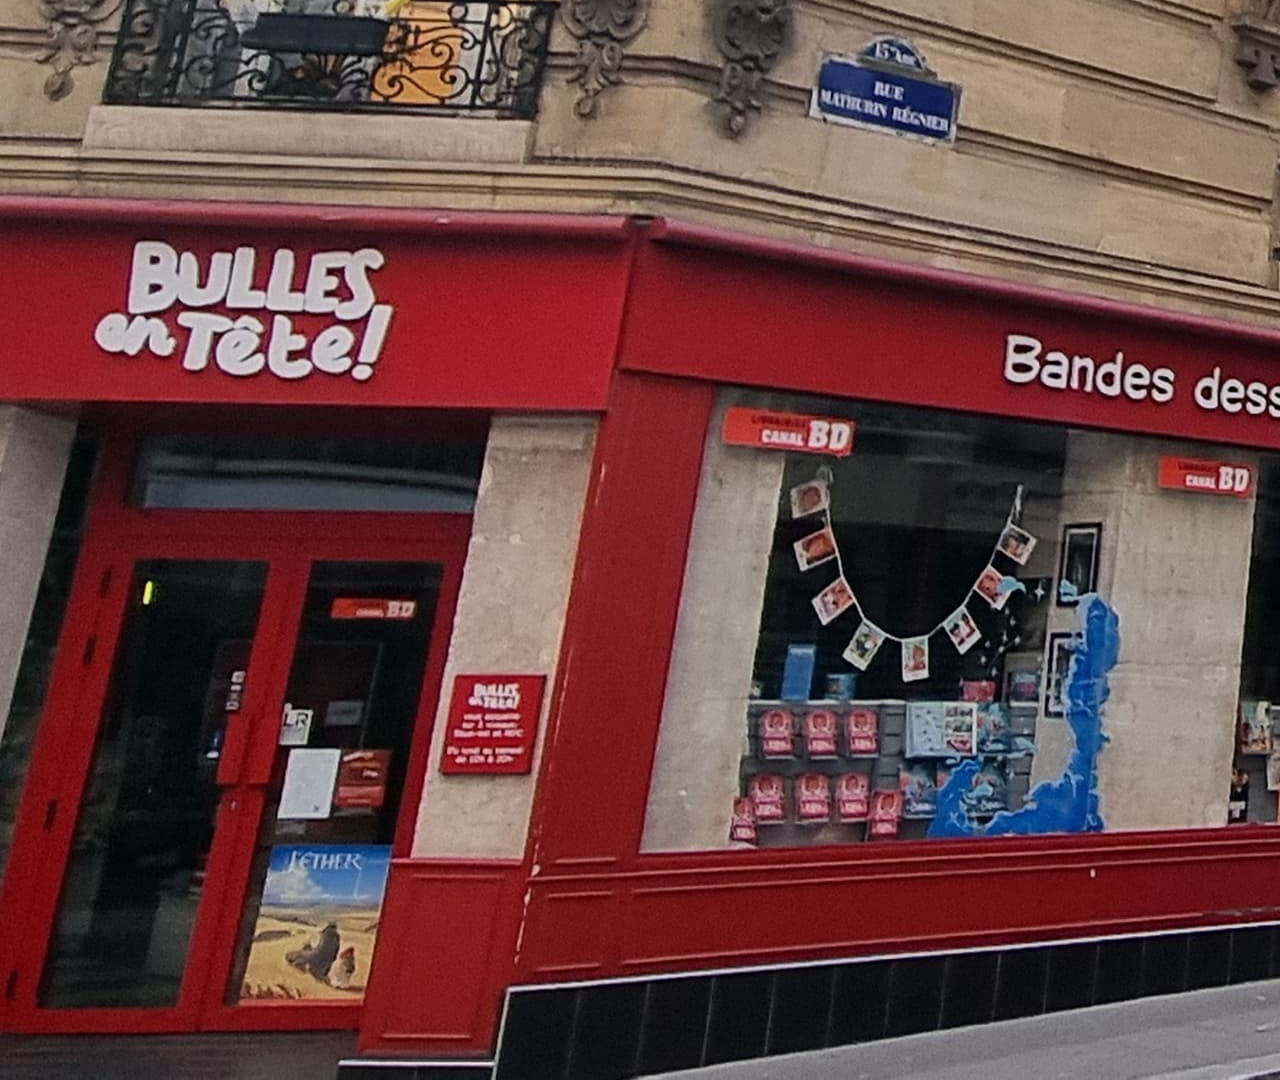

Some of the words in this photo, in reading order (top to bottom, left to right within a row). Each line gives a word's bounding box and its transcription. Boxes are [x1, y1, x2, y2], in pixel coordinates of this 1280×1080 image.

[874, 81, 904, 100] RUE
[820, 89, 888, 118] MATHURIN
[892, 106, 949, 132] RÉGNIER
[128, 241, 385, 320] BULLES
[94, 313, 177, 356] en
[176, 304, 393, 381] Tête!
[1004, 334, 1175, 402] Bandes
[761, 429, 804, 447] CANAL
[808, 419, 851, 450] BD
[1219, 466, 1250, 492] BD
[386, 601, 416, 617] BD
